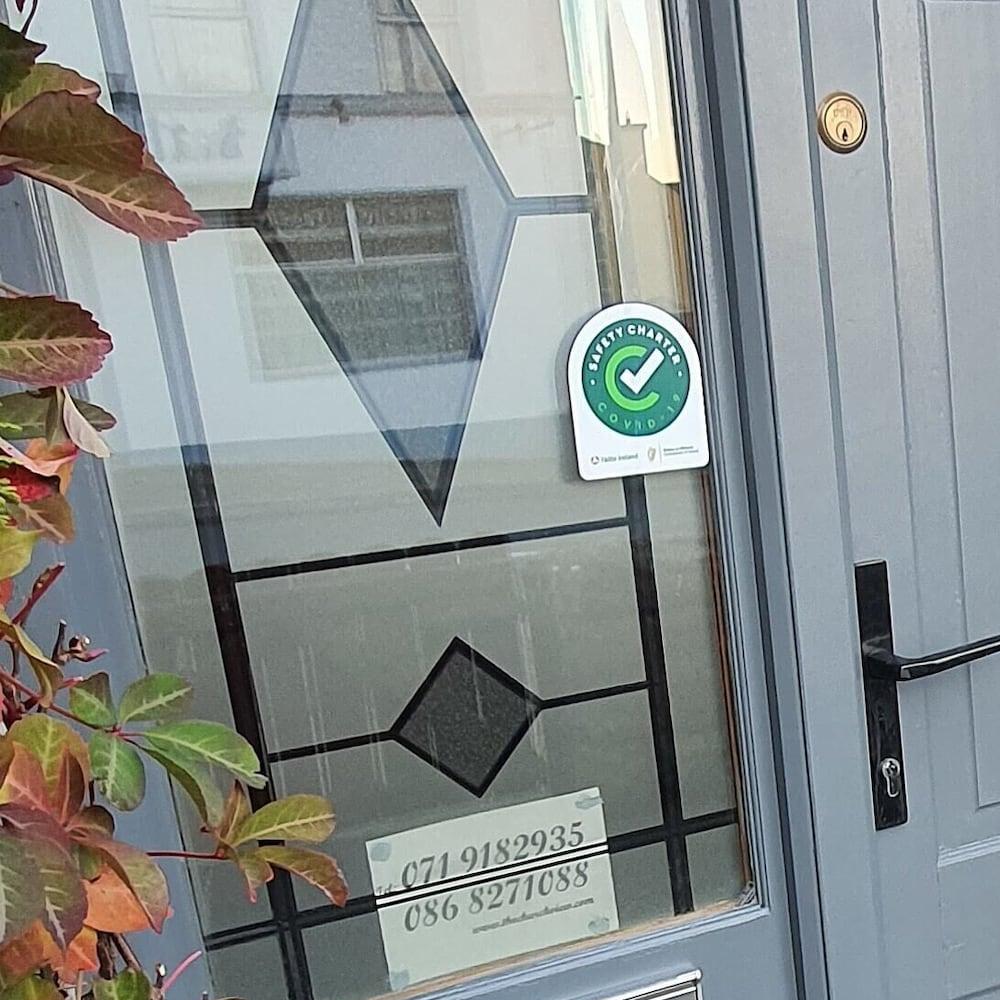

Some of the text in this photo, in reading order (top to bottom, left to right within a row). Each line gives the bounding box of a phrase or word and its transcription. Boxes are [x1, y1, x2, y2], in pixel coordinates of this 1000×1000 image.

[588, 324, 682, 372] SAFETY CHARTER
[598, 393, 681, 430] COVID-19
[401, 821, 584, 889] 071 9182935
[404, 894, 459, 932] 086
[469, 860, 589, 915] 8271088
